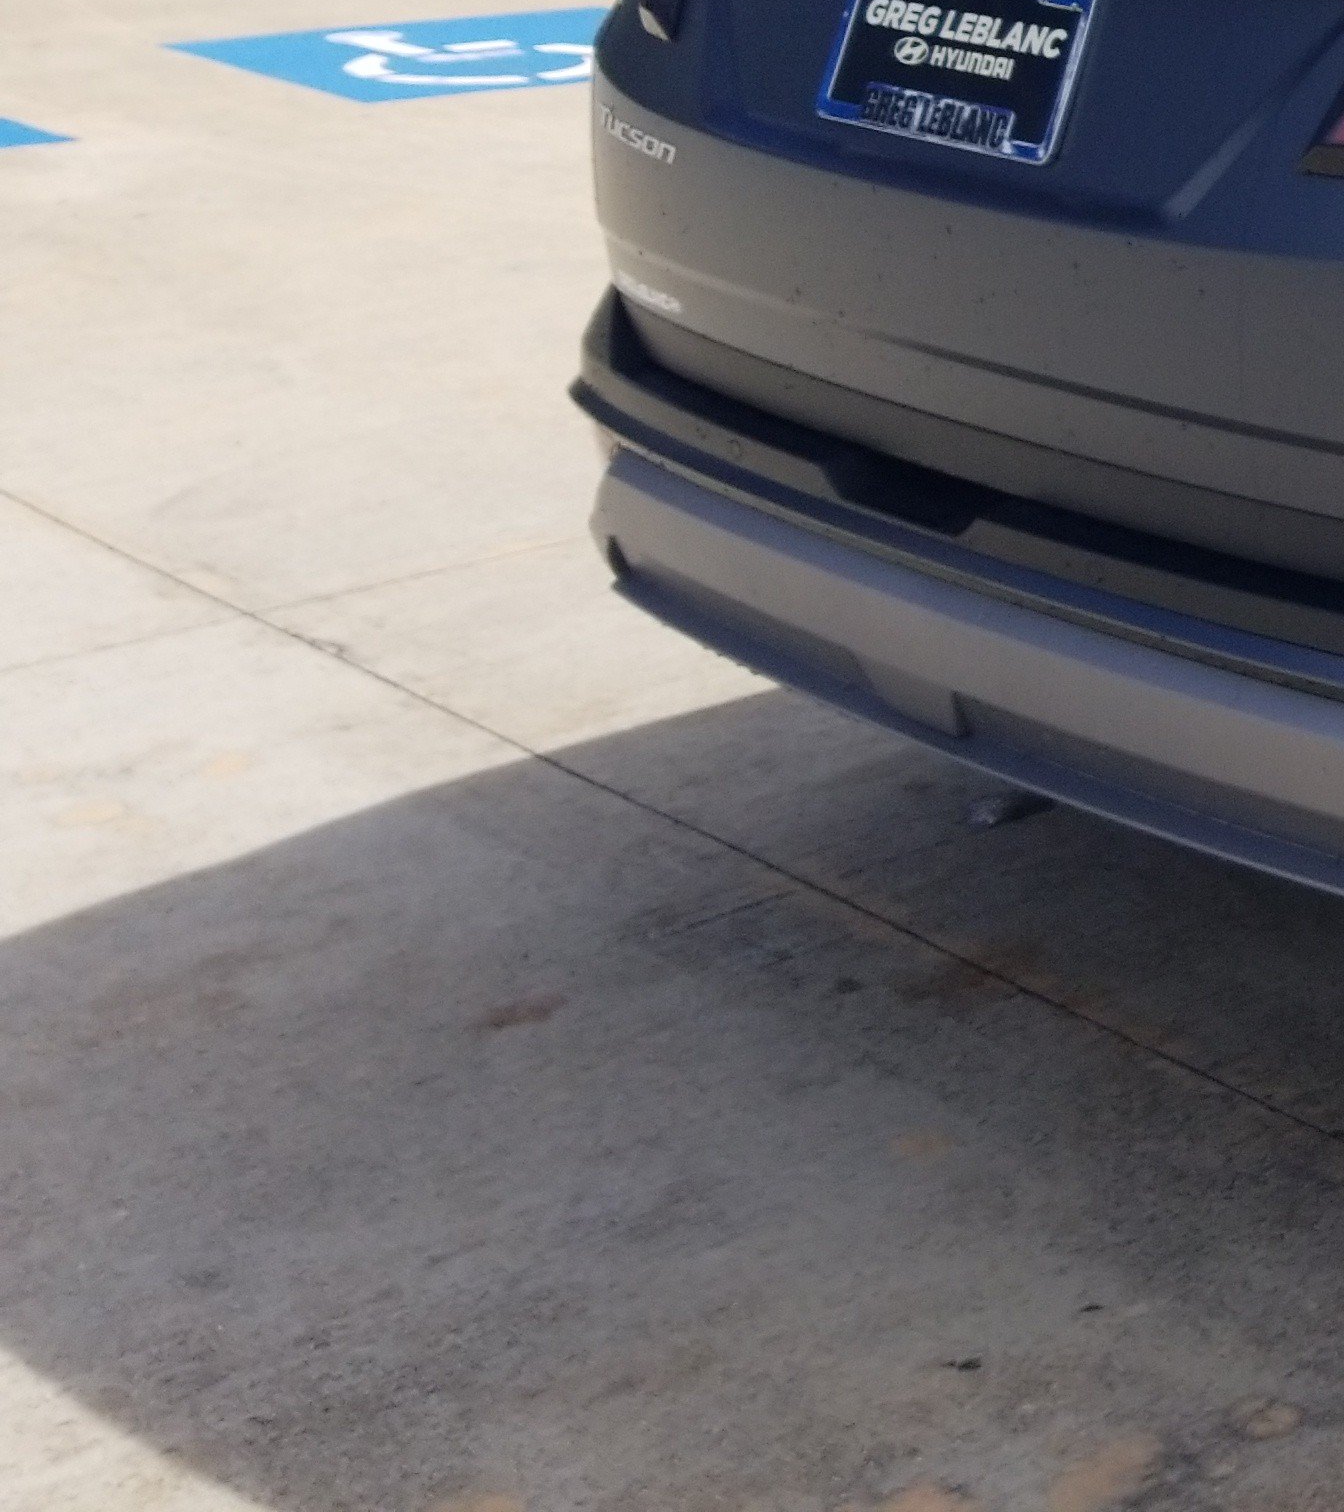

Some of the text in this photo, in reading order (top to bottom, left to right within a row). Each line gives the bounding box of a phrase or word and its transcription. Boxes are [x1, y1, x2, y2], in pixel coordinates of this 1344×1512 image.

[939, 10, 1068, 59] LEBLANC
[929, 44, 1015, 80] HYUNDAI
[600, 105, 676, 164] TUCSON
